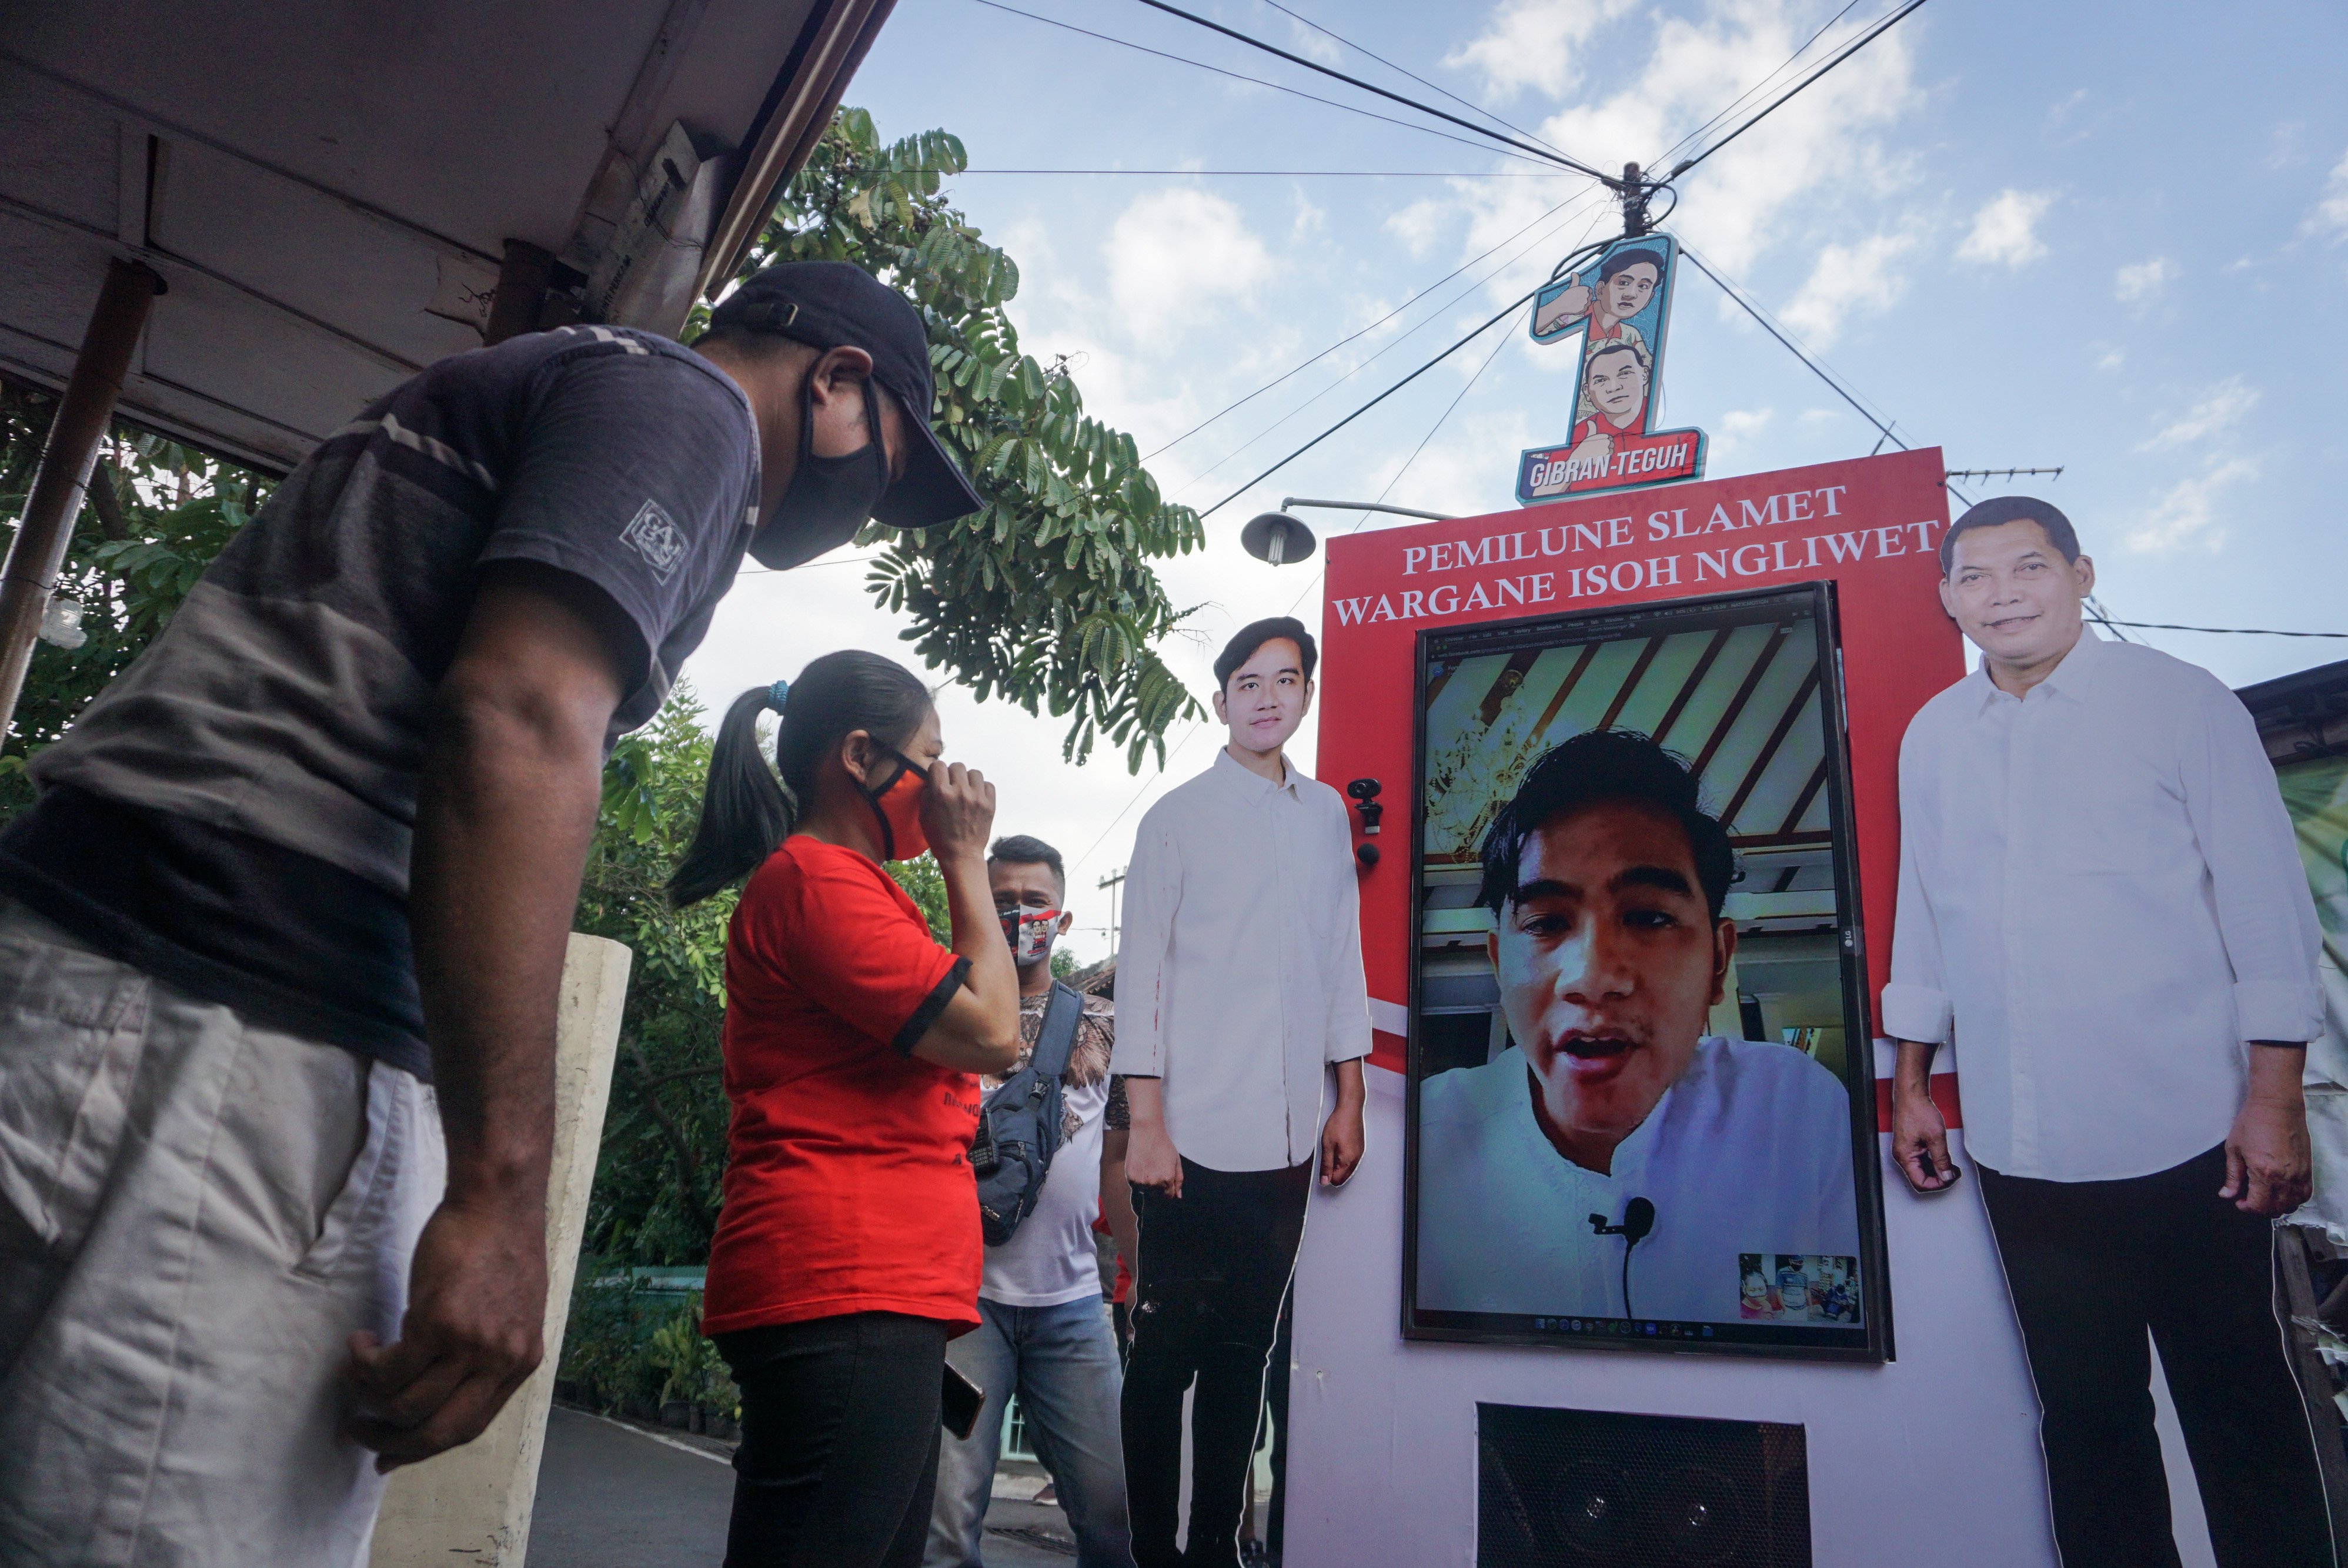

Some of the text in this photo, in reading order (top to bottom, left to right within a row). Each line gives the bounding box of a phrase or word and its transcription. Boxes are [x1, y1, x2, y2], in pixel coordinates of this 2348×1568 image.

[1529, 443, 1688, 488] GIBRAN-TEGUH
[1402, 486, 1845, 576] PEMILUNE SLAMET
[1332, 520, 1939, 627] WARGANE ISOH NGLIWET
[1845, 931, 1851, 939] LG
